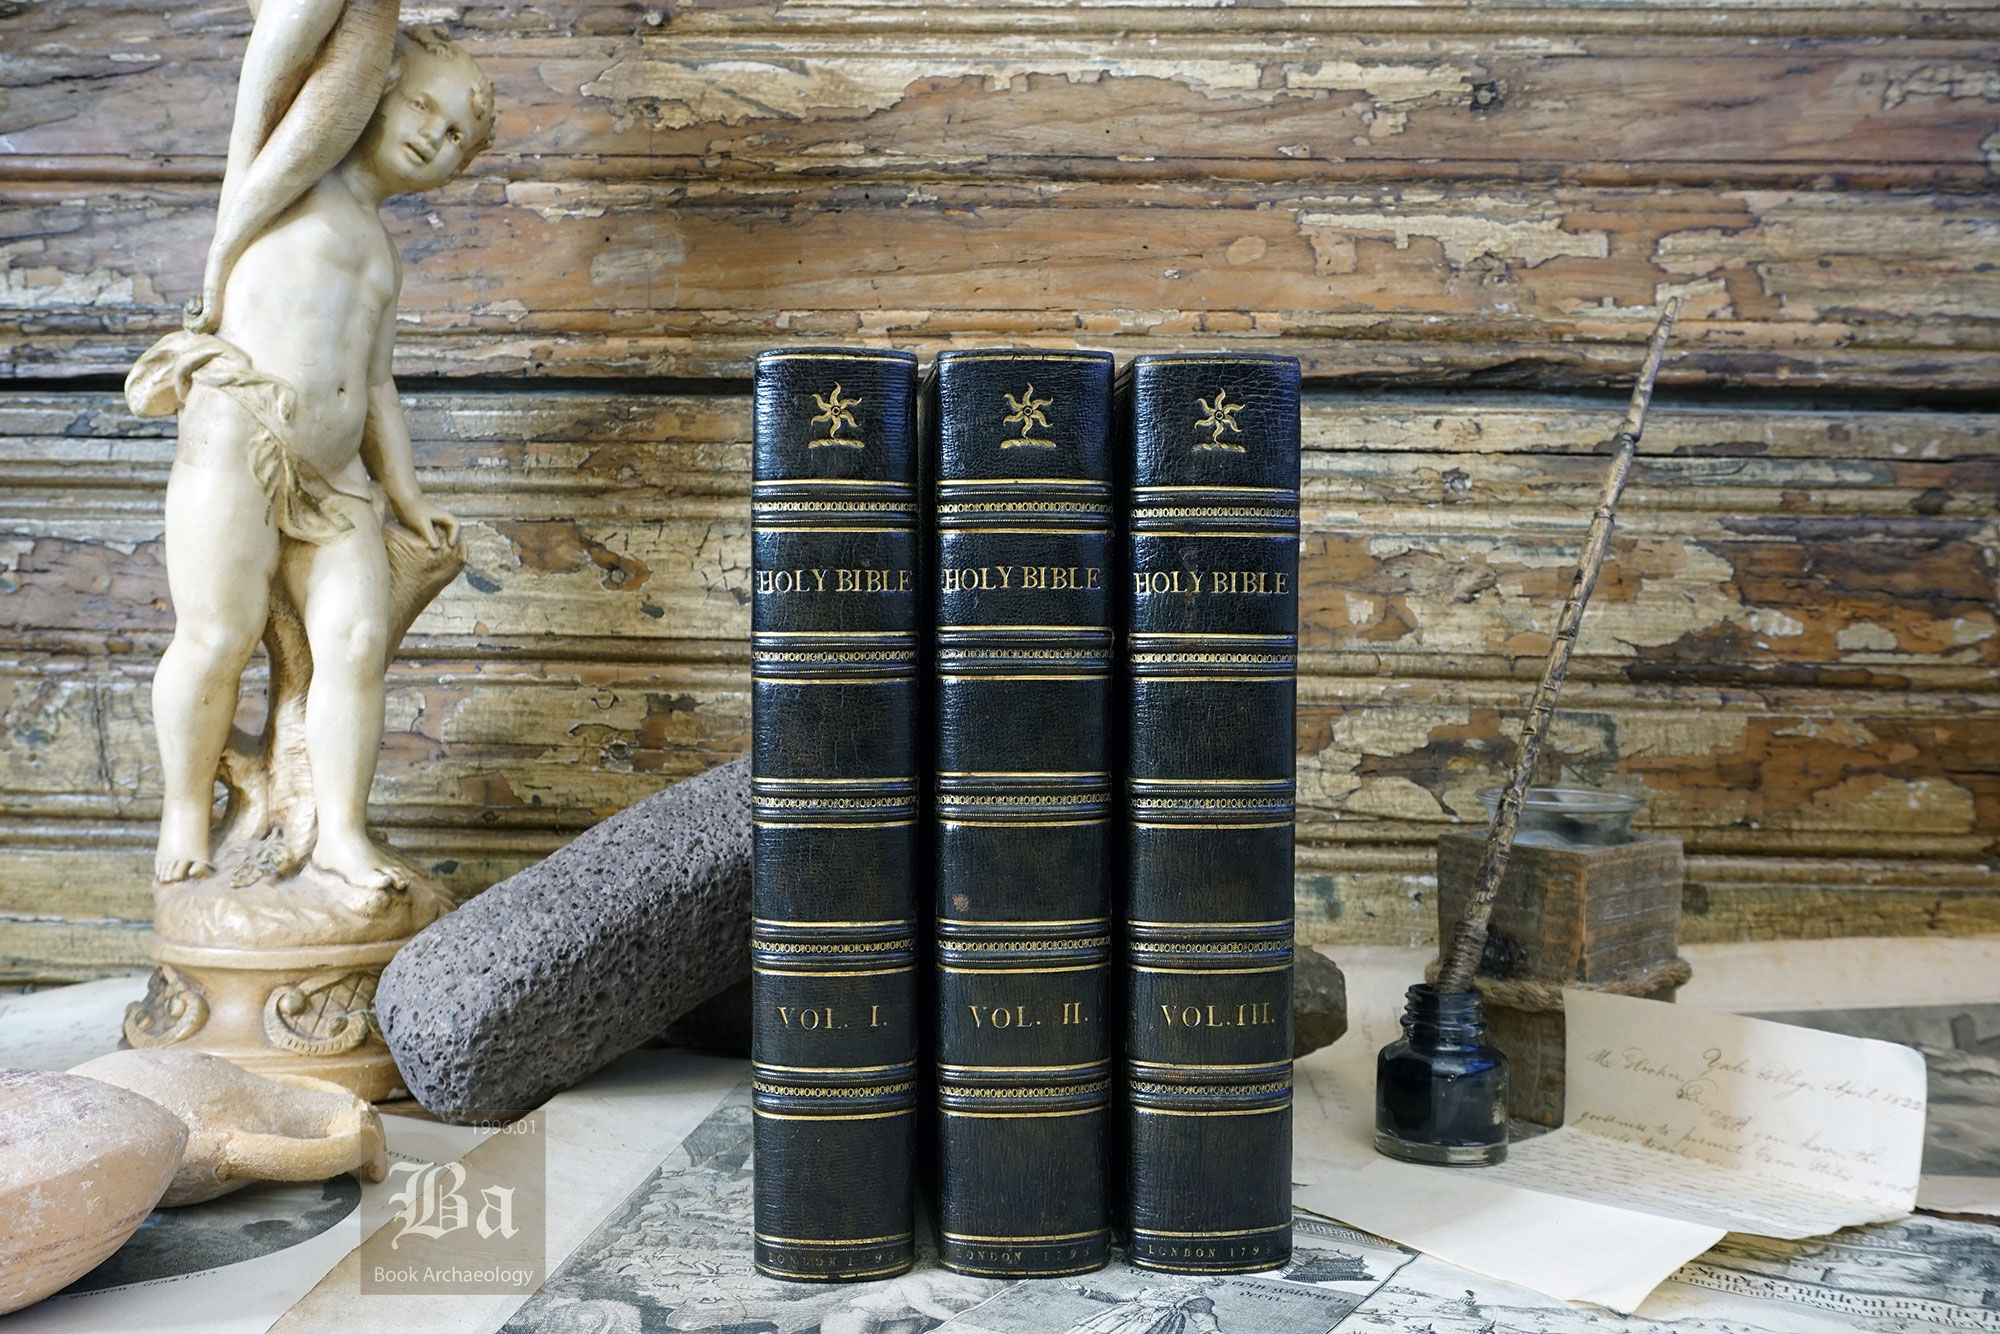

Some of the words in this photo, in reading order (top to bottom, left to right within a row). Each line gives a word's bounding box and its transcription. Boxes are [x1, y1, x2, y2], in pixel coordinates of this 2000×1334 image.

[756, 569, 828, 594] HOLY
[835, 569, 913, 593] BIBLE
[942, 566, 1013, 592] HOLY
[1020, 566, 1101, 590] BIBLE
[1132, 570, 1206, 595] HOLY
[1210, 571, 1290, 594] BIBLE
[776, 1006, 849, 1030] VOL.
[869, 1004, 888, 1027] I.
[968, 1005, 1042, 1029] VOL.
[1062, 1002, 1089, 1025] II.
